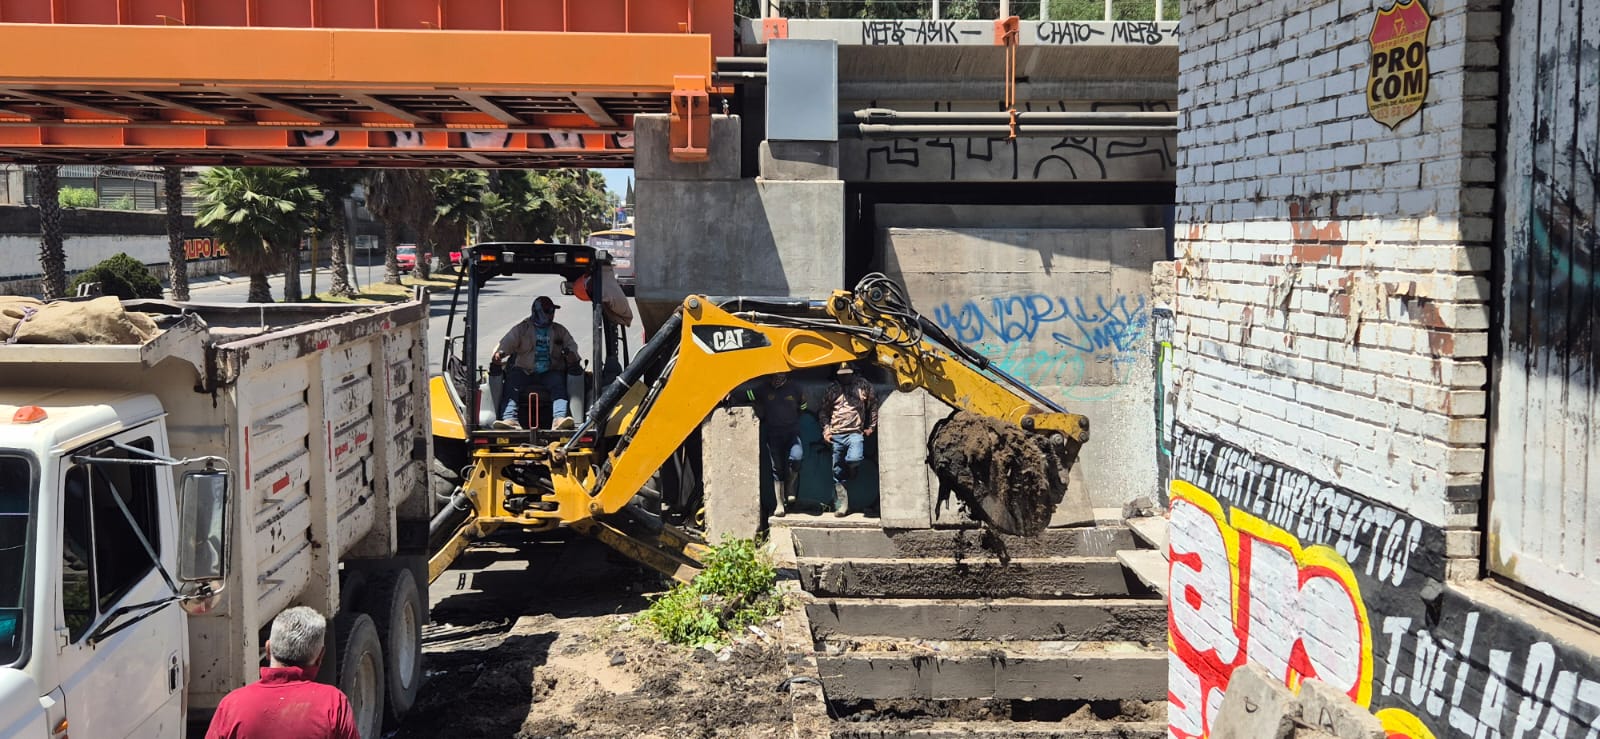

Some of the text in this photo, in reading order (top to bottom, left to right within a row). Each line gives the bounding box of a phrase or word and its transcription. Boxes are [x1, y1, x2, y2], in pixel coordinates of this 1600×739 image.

[1373, 42, 1423, 77] PRO
[1372, 69, 1422, 102] COM
[713, 329, 744, 350] CAT
